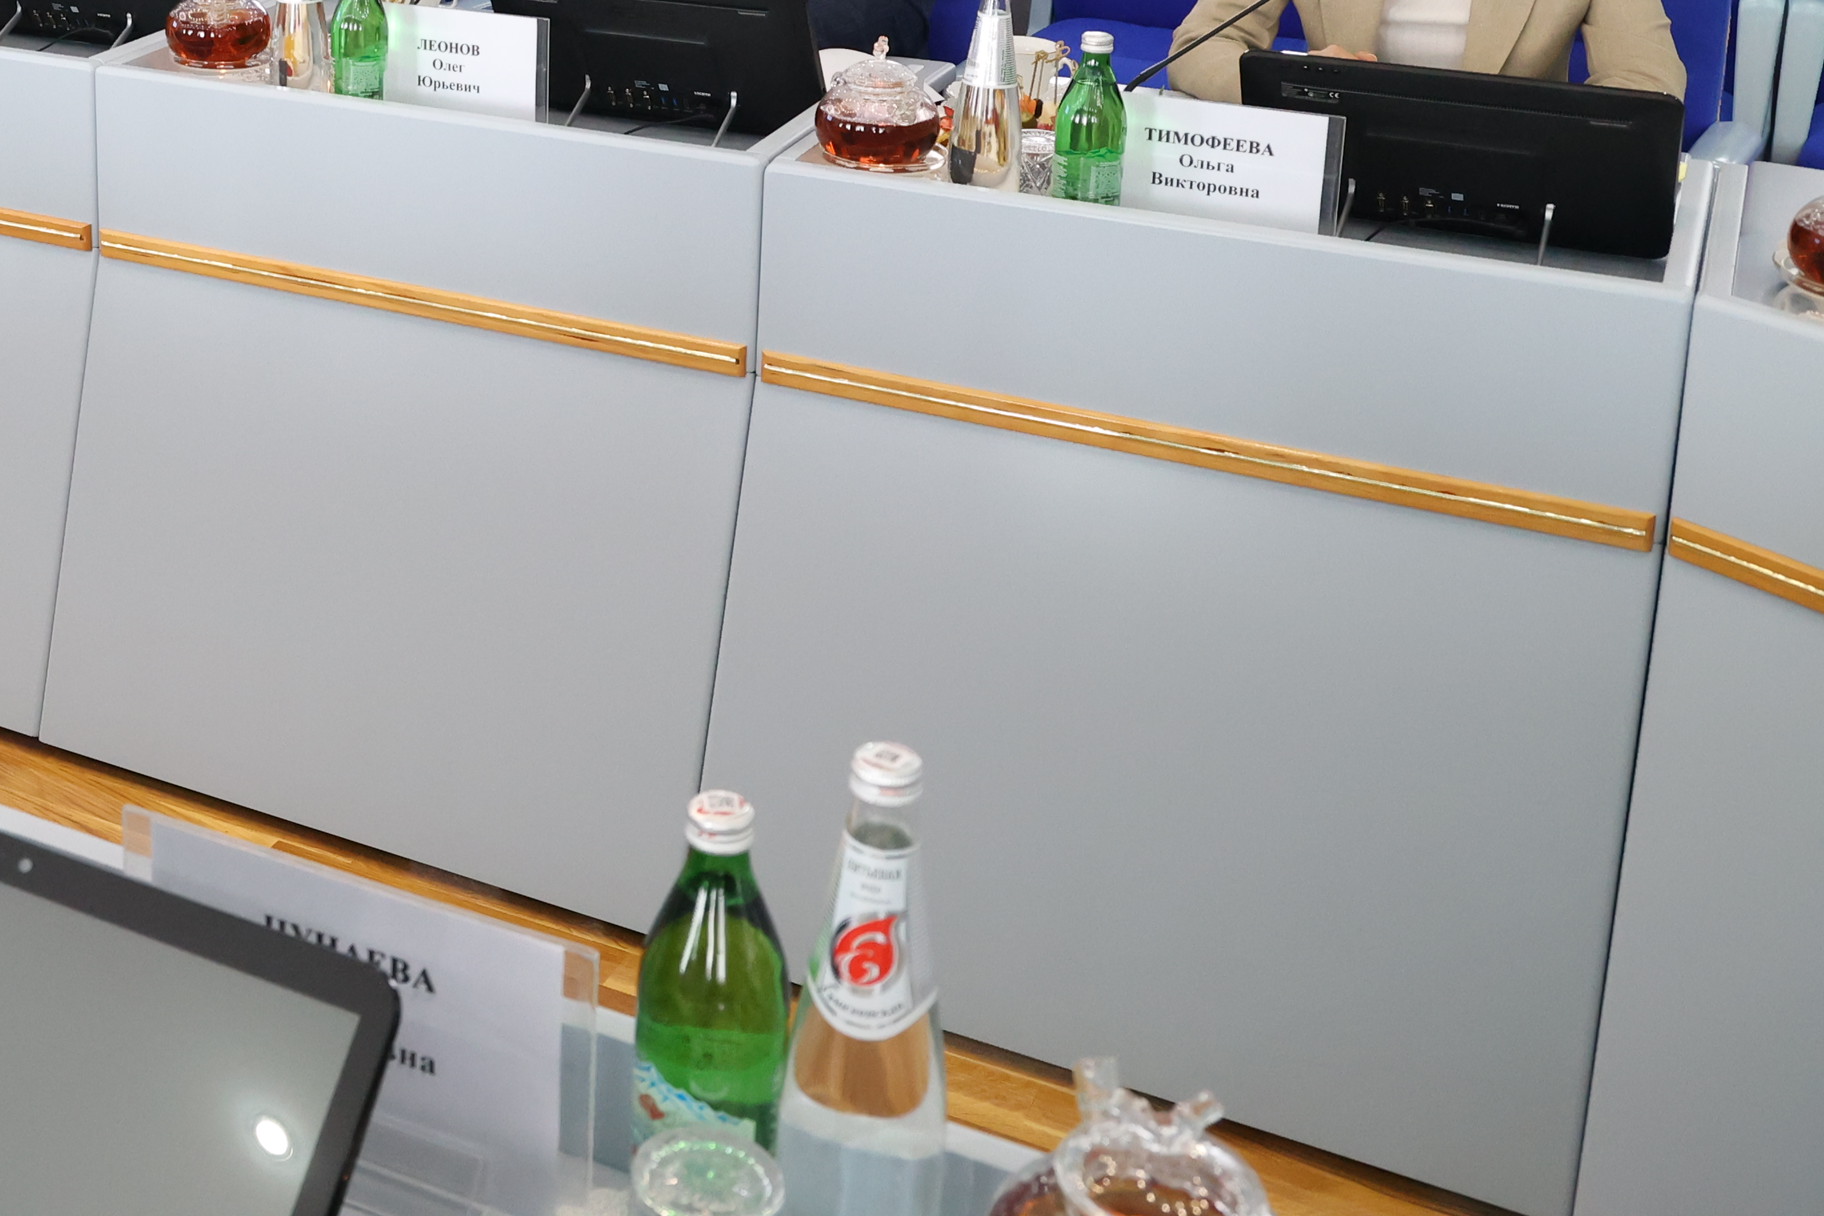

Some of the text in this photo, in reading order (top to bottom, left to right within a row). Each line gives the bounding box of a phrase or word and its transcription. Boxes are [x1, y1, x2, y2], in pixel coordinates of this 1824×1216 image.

[417, 38, 481, 57] ЛЕОНОВ
[432, 57, 466, 73] Олег
[416, 74, 481, 94] Юрьевич
[1144, 127, 1275, 157] ТИМОФЕЕВА
[1179, 153, 1235, 173] Ольга
[1151, 171, 1260, 199] Викторовна
